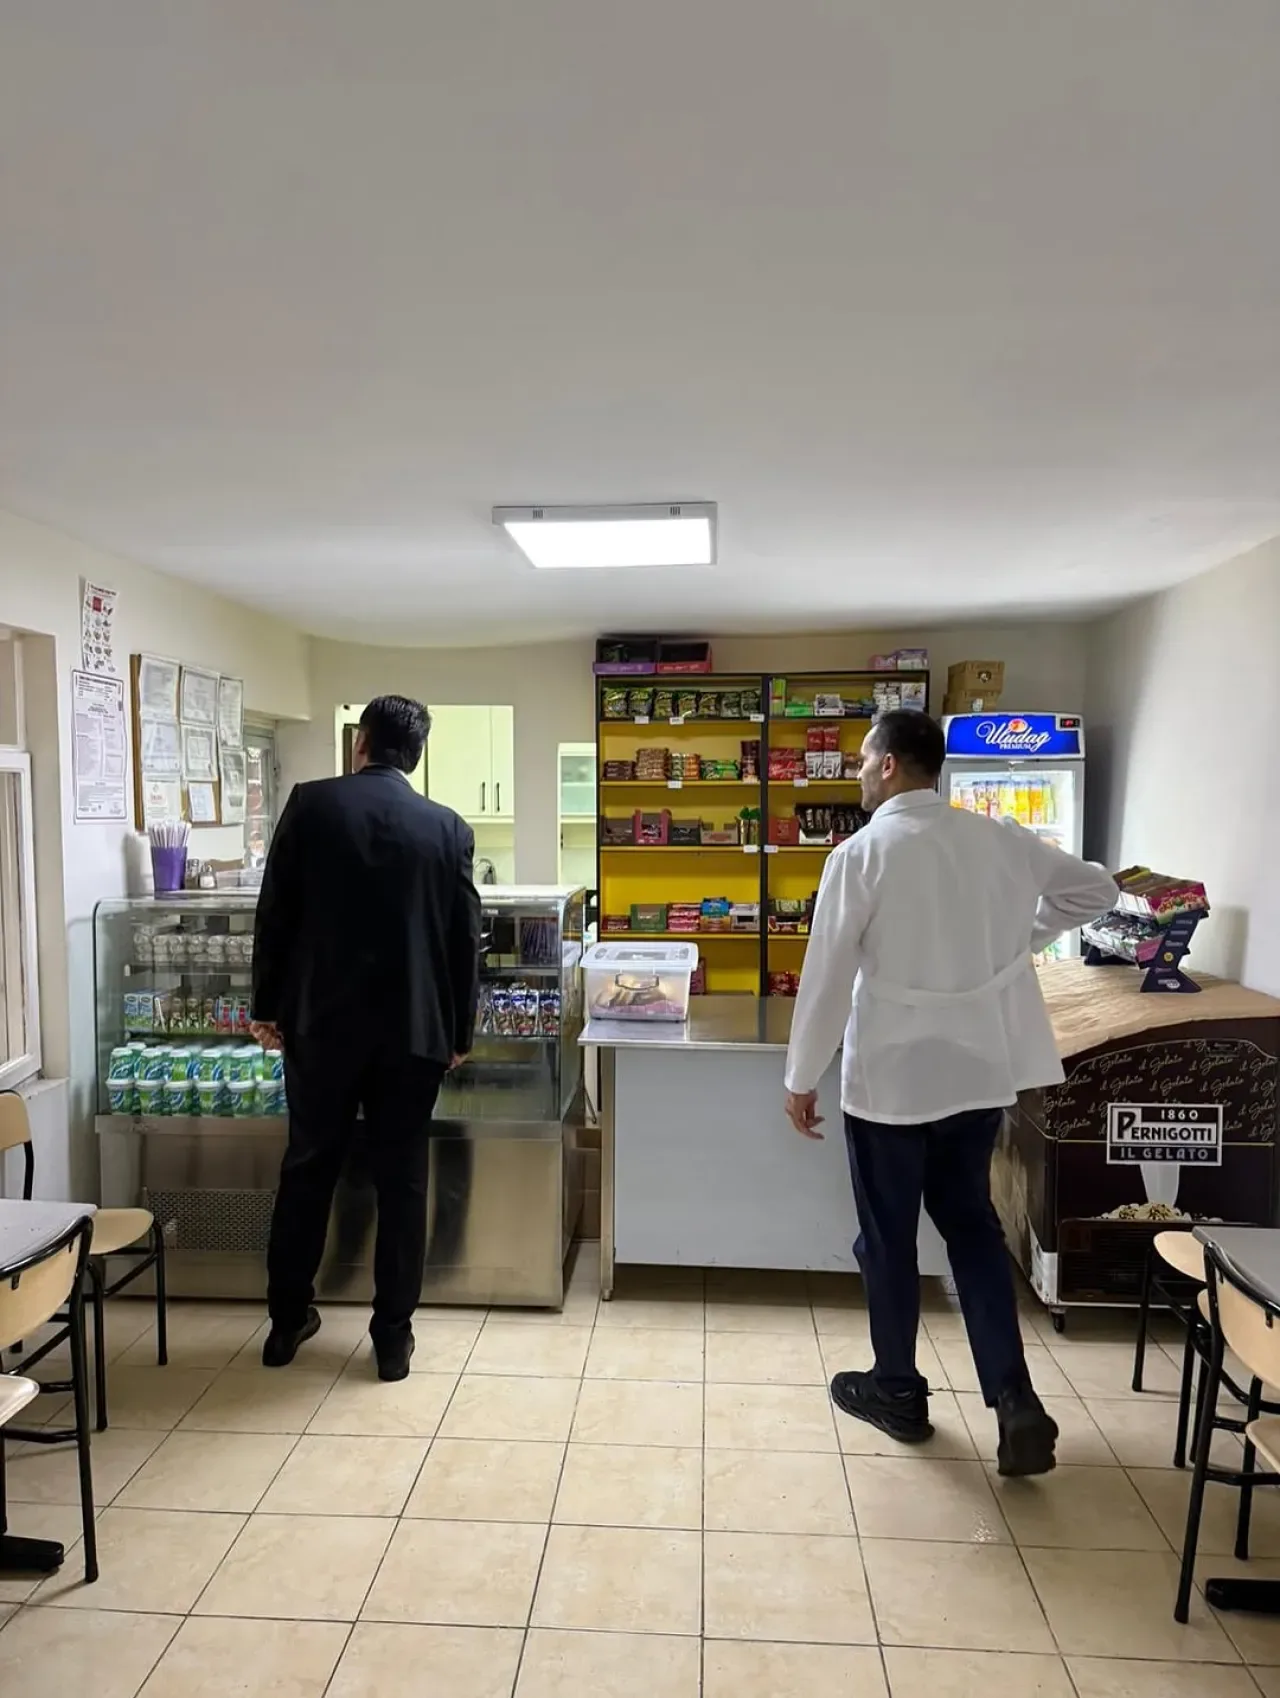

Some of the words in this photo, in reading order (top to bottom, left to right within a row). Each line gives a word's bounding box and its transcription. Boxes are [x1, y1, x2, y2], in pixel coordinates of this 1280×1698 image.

[1161, 1109, 1199, 1120] 1860
[1117, 1111, 1212, 1141] PERNIGOTTI
[1121, 1147, 1135, 1159] IL
[1142, 1147, 1208, 1160] GELATO
